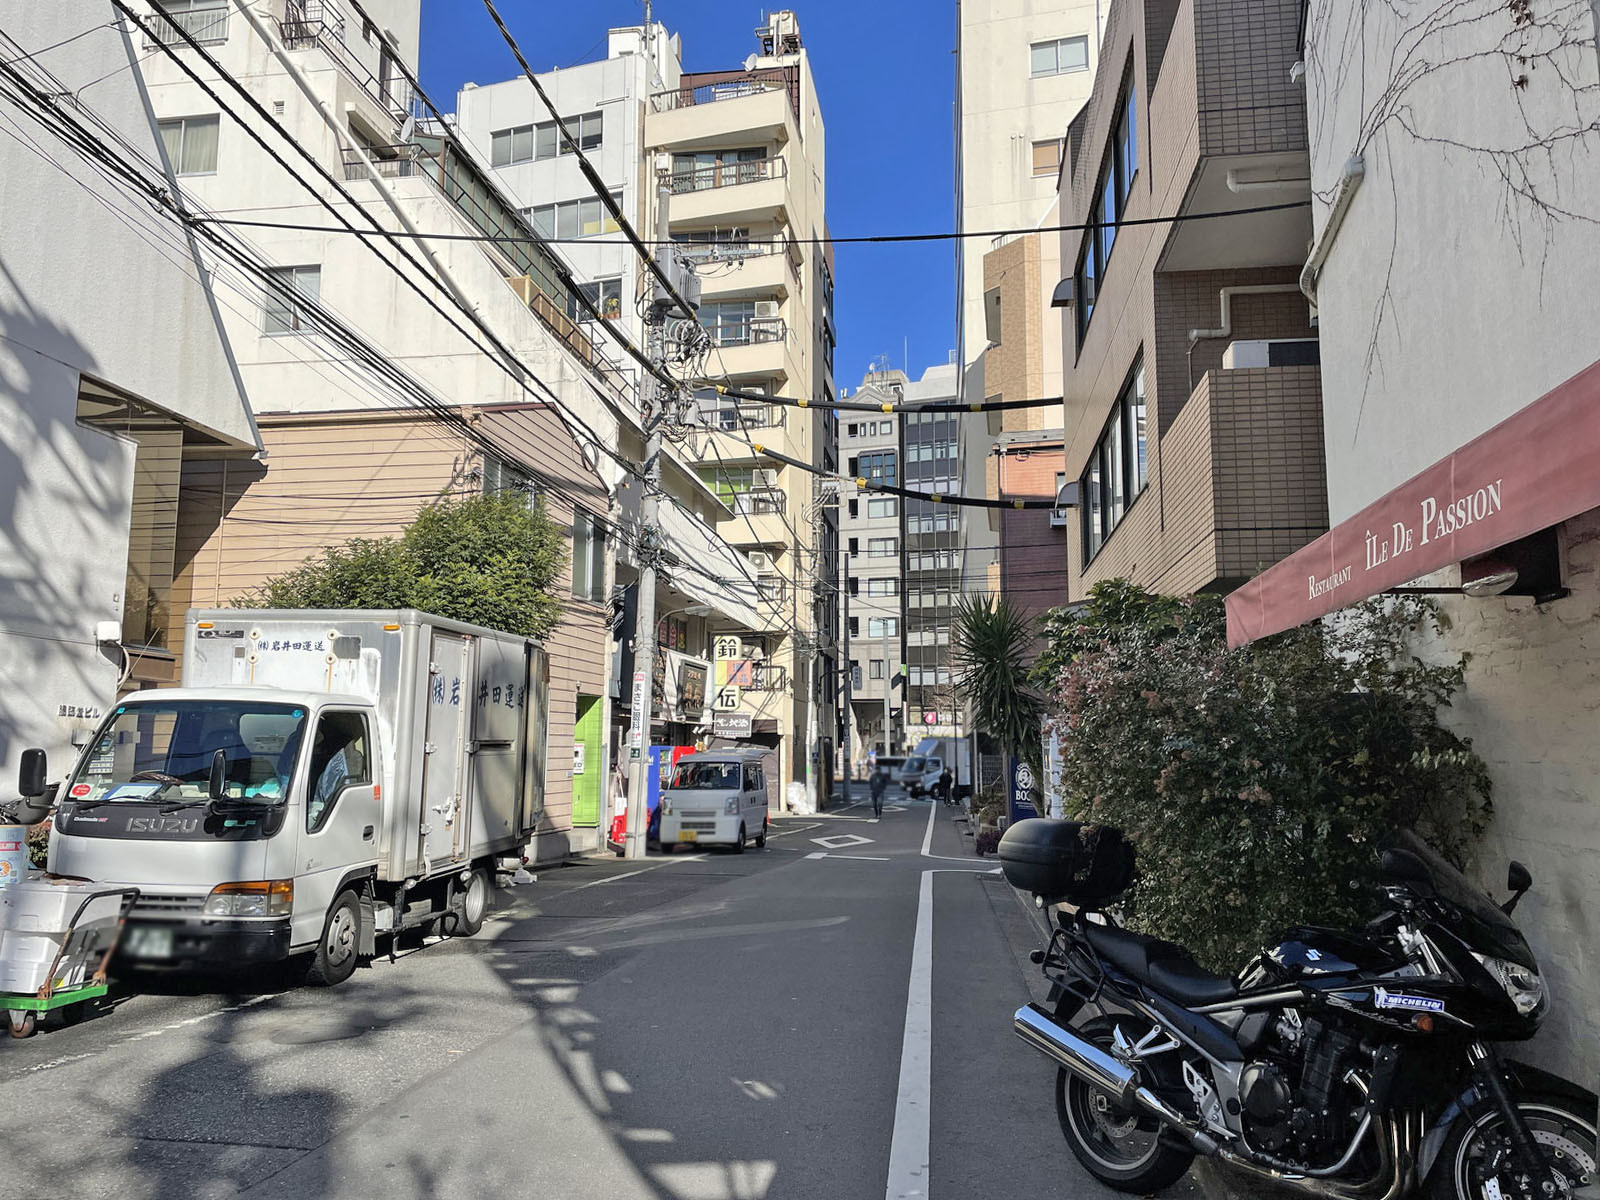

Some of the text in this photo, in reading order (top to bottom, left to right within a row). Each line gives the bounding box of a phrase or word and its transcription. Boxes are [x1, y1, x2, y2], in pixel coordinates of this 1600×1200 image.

[1420, 478, 1504, 546] PASSION
[125, 817, 199, 833] ISUZU
[1387, 996, 1441, 1009] MICHELIN
